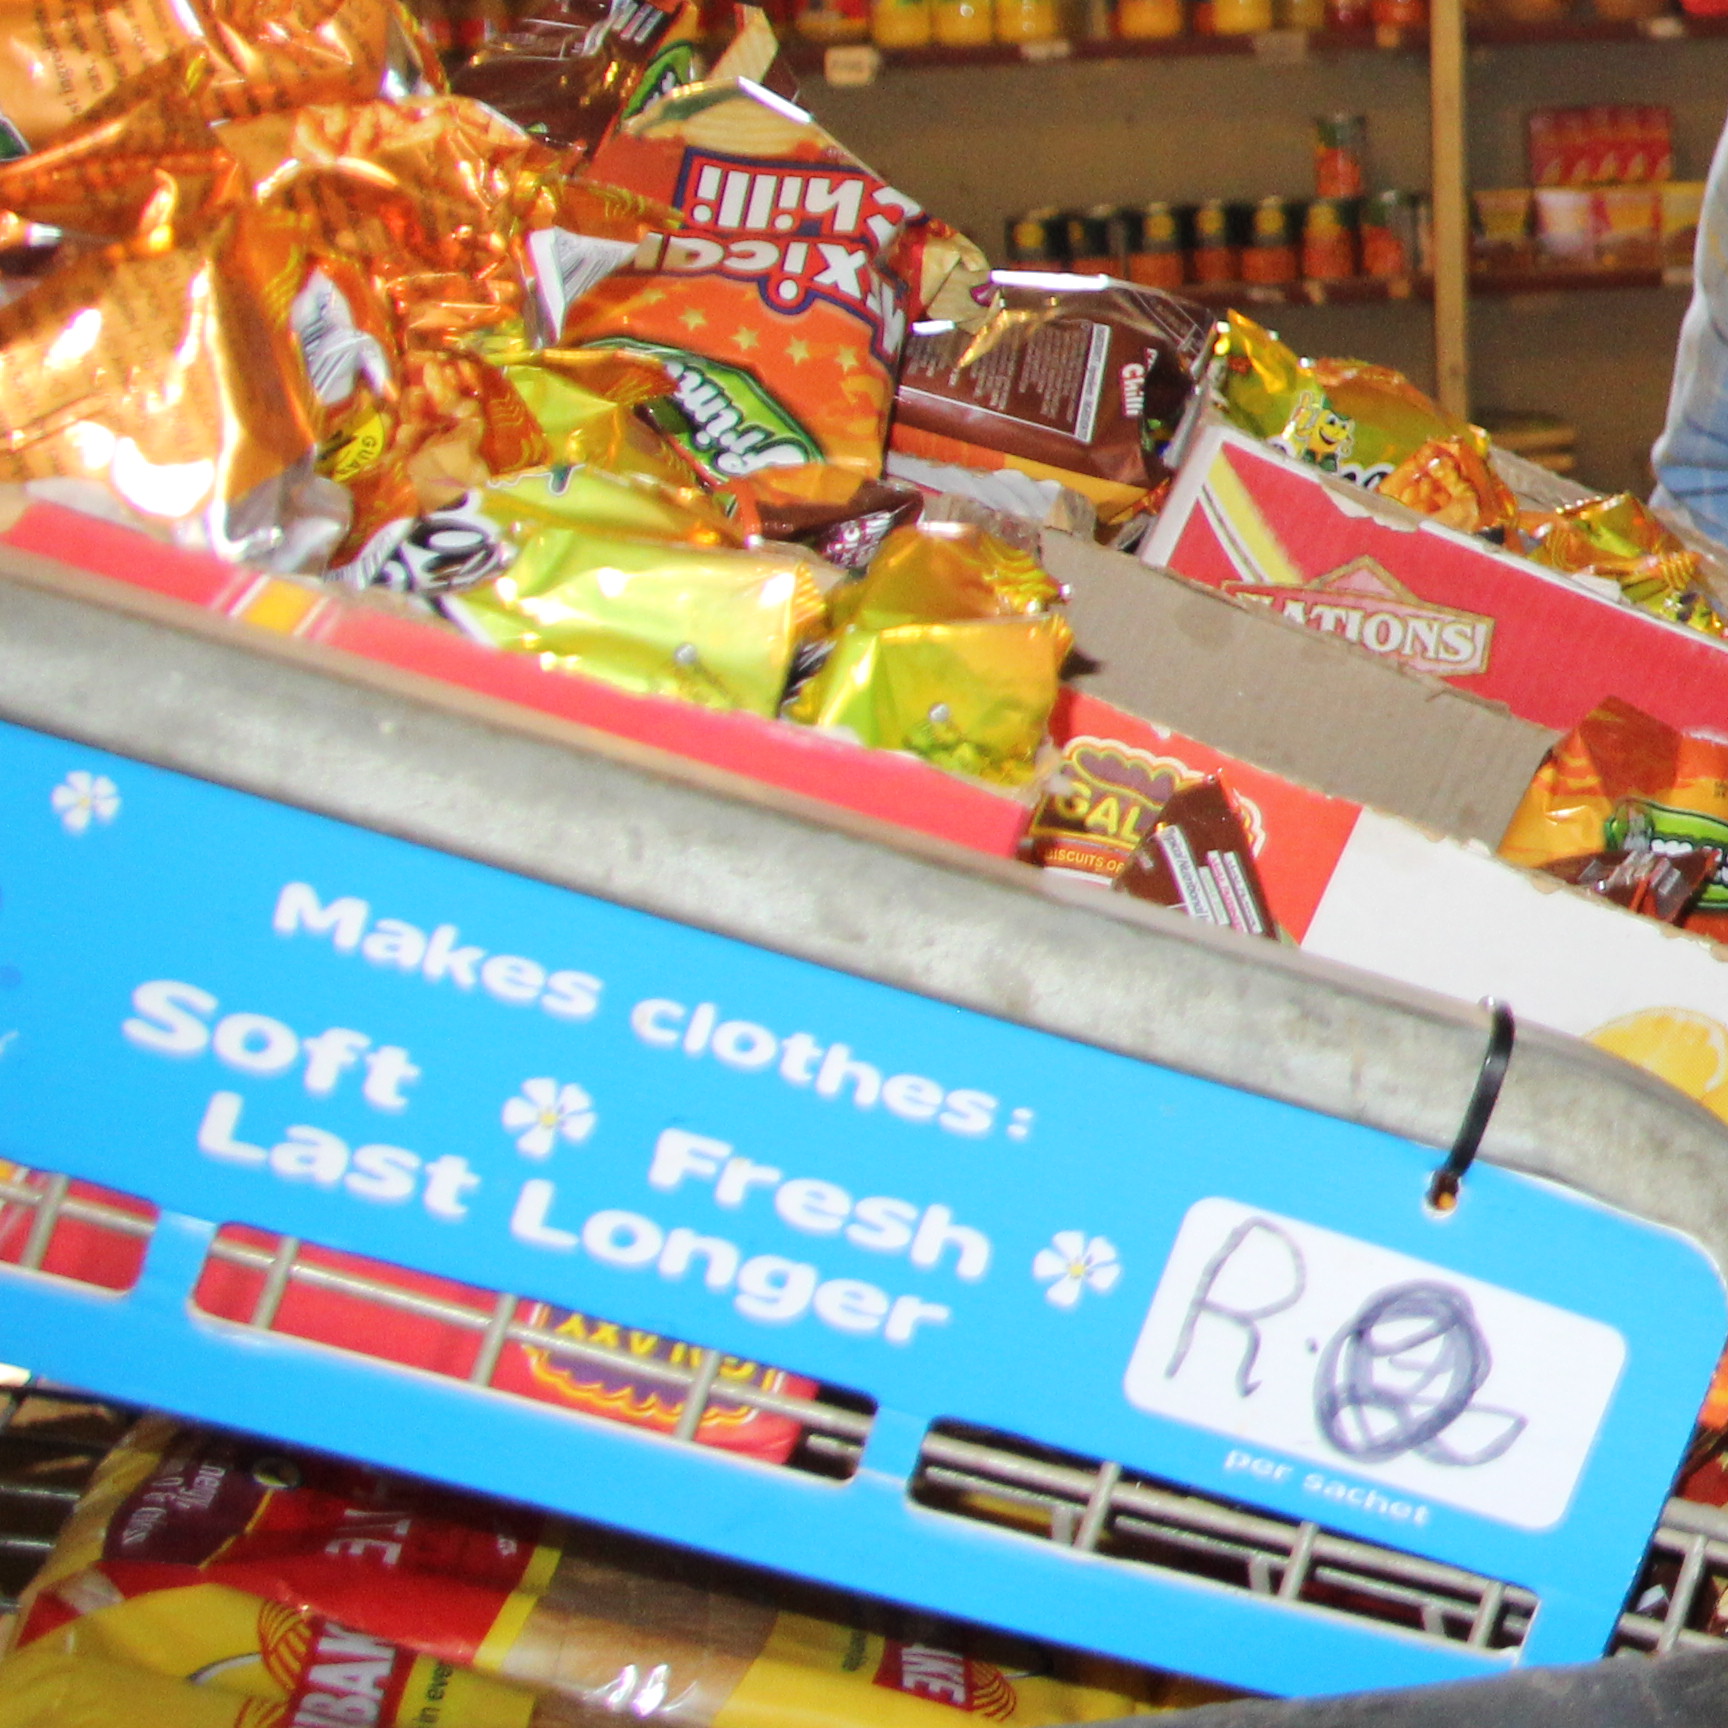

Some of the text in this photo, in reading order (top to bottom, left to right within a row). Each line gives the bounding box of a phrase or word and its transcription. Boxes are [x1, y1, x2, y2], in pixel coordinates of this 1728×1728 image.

[688, 162, 927, 250] Chilli
[1119, 362, 1146, 418] Chilli
[1236, 591, 1477, 664] ATIONS
[1056, 778, 1146, 843] GAL
[120, 977, 423, 1114] Soft
[270, 879, 1037, 1142] Makes clothes:
[194, 1091, 951, 1348] Last Longer
[647, 1124, 993, 1283] Fresh
[1224, 1447, 1433, 1528] per sachet
[901, 1642, 967, 1707] KE
